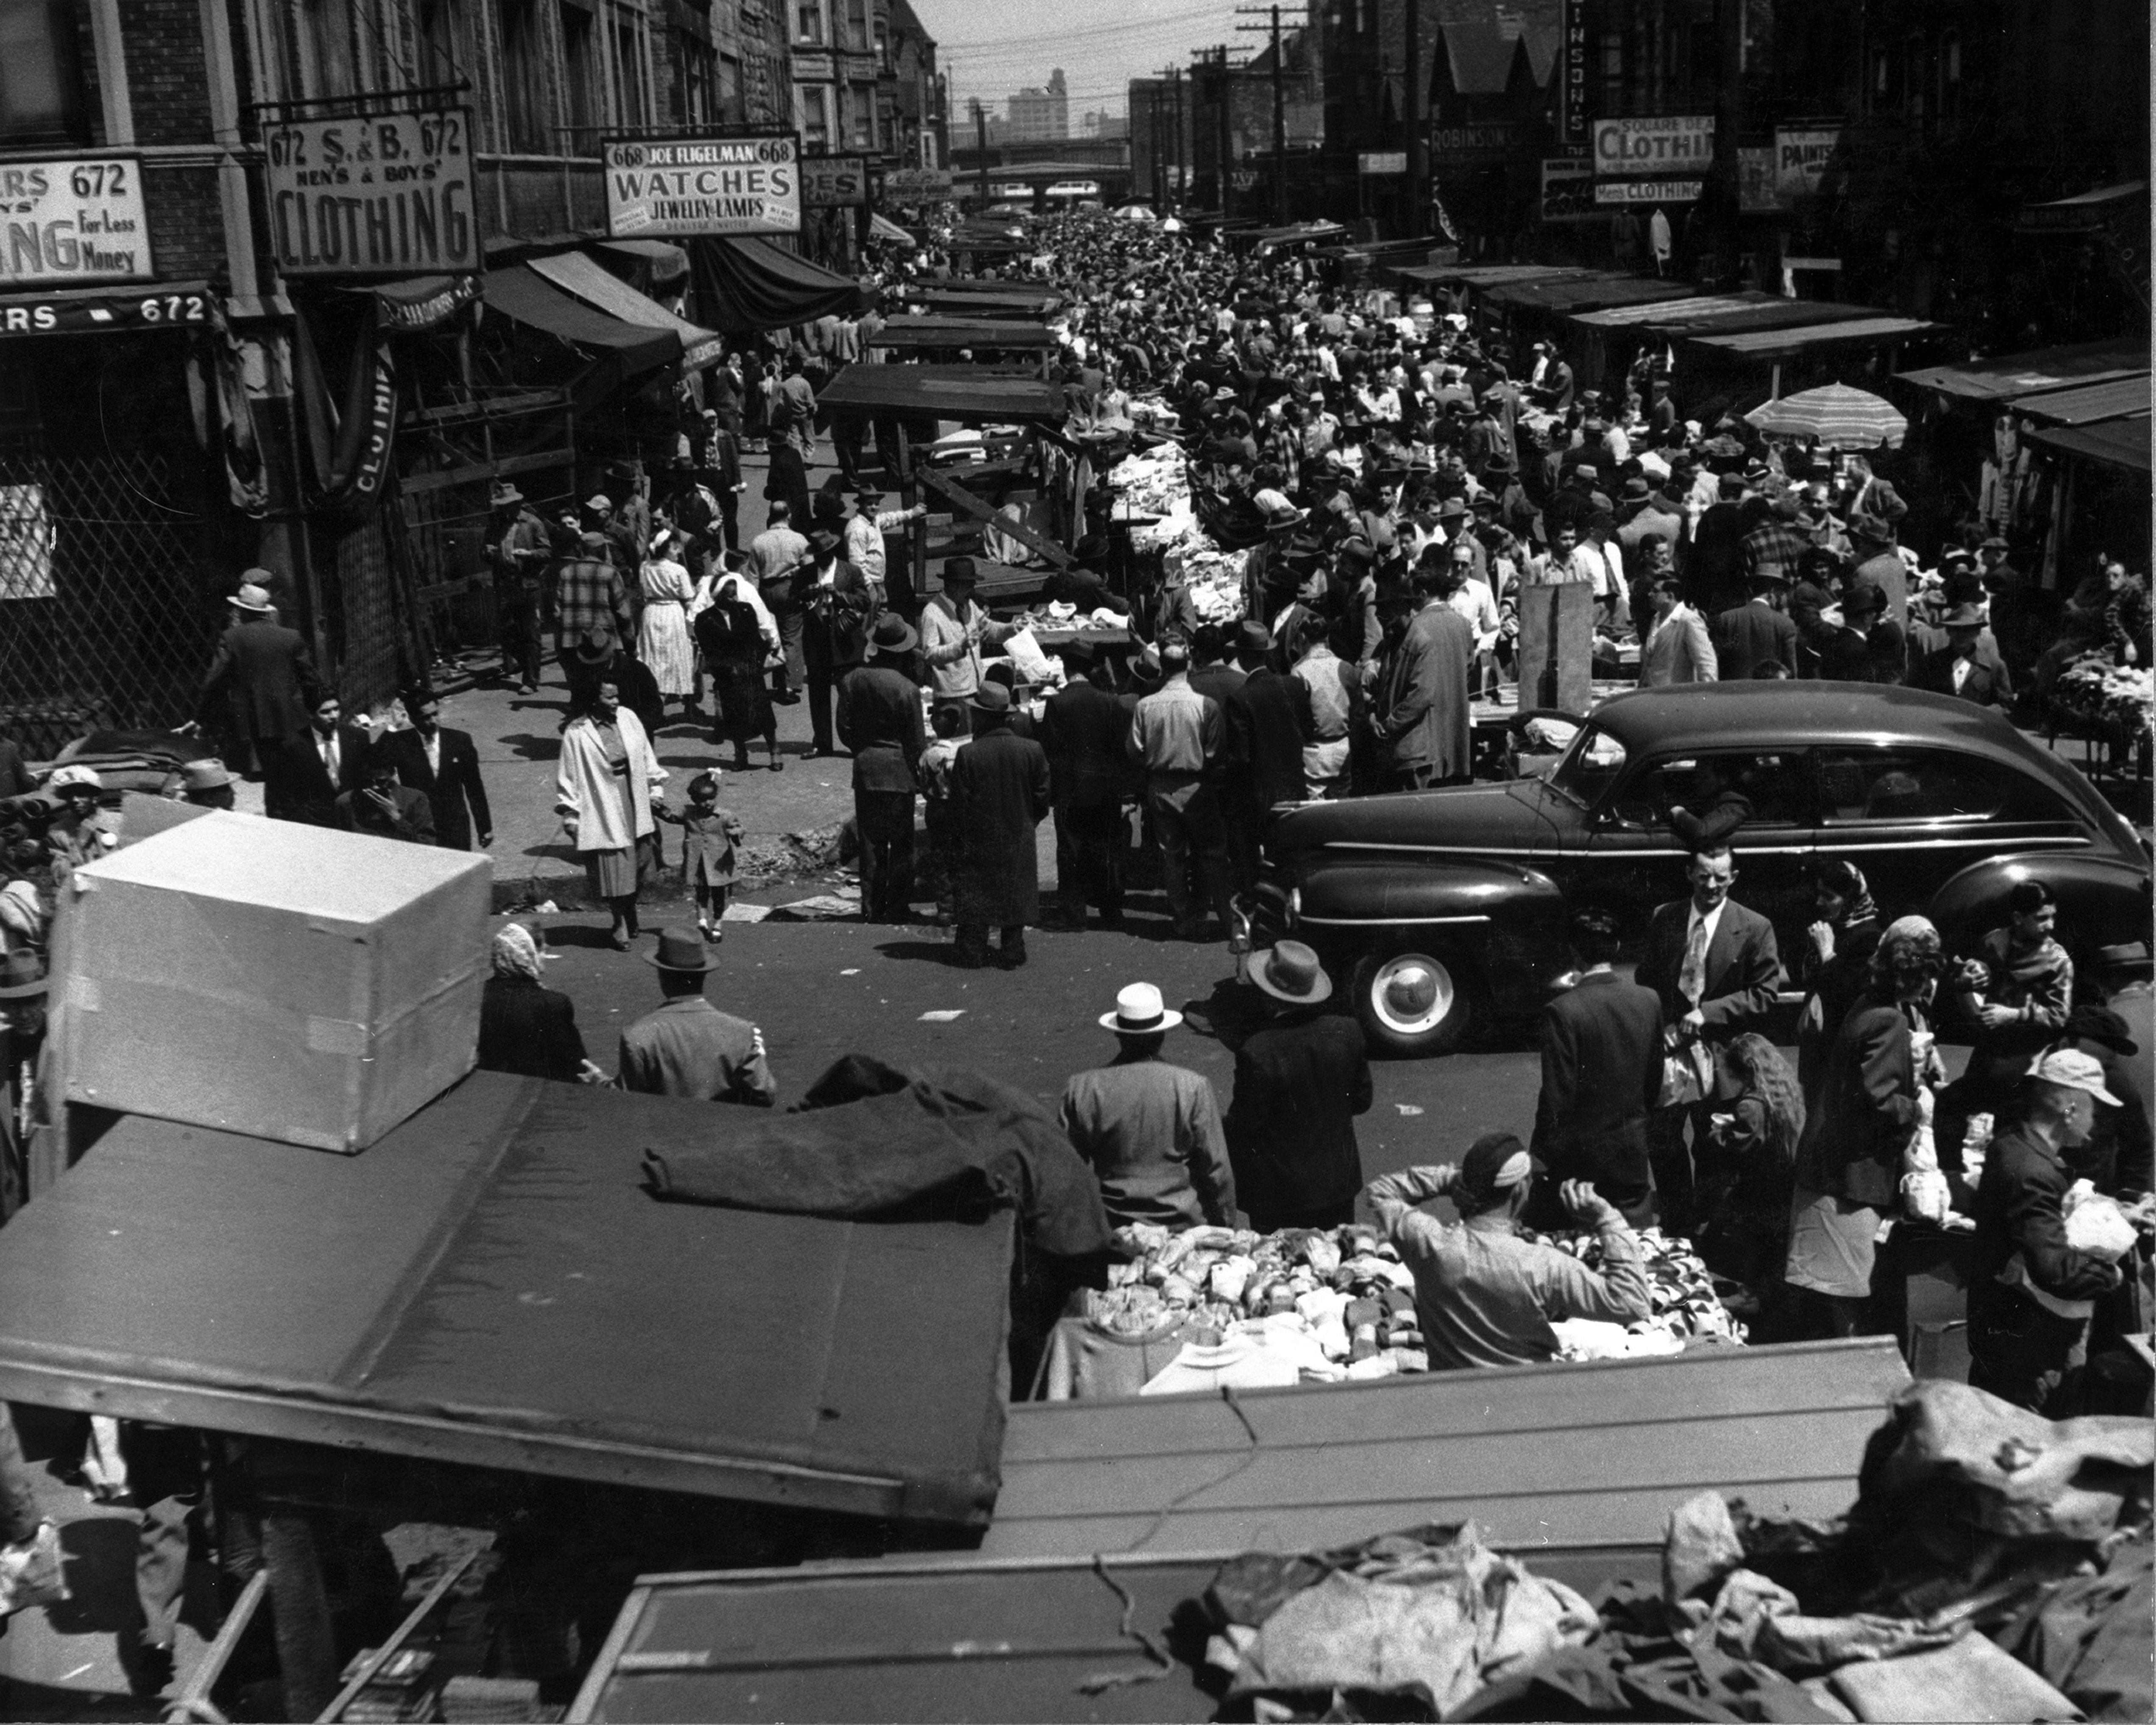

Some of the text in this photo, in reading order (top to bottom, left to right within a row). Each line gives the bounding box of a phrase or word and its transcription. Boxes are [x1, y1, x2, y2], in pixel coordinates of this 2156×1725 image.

[1570, 0, 1584, 131] INSON'S
[1623, 119, 1679, 133] SQUARE
[270, 131, 305, 166] 672
[322, 128, 352, 164] S.
[377, 124, 409, 159] B.
[421, 119, 460, 156] 672
[614, 141, 789, 167] 668 JOE FLIGELMAN 668
[1782, 144, 1834, 170] PAINTS
[0, 165, 125, 197] RS 672
[296, 159, 442, 185] MEN'S & BOYS'
[615, 168, 790, 202] WATCHES
[1628, 182, 1701, 198] CLOTHING
[78, 209, 134, 233] For Less
[276, 180, 467, 266] CLOTHING
[650, 199, 711, 219] JEWELRY
[716, 198, 763, 218] LAMPS
[0, 220, 79, 273] NG
[82, 241, 134, 274] Money
[0, 296, 204, 332] RS 672
